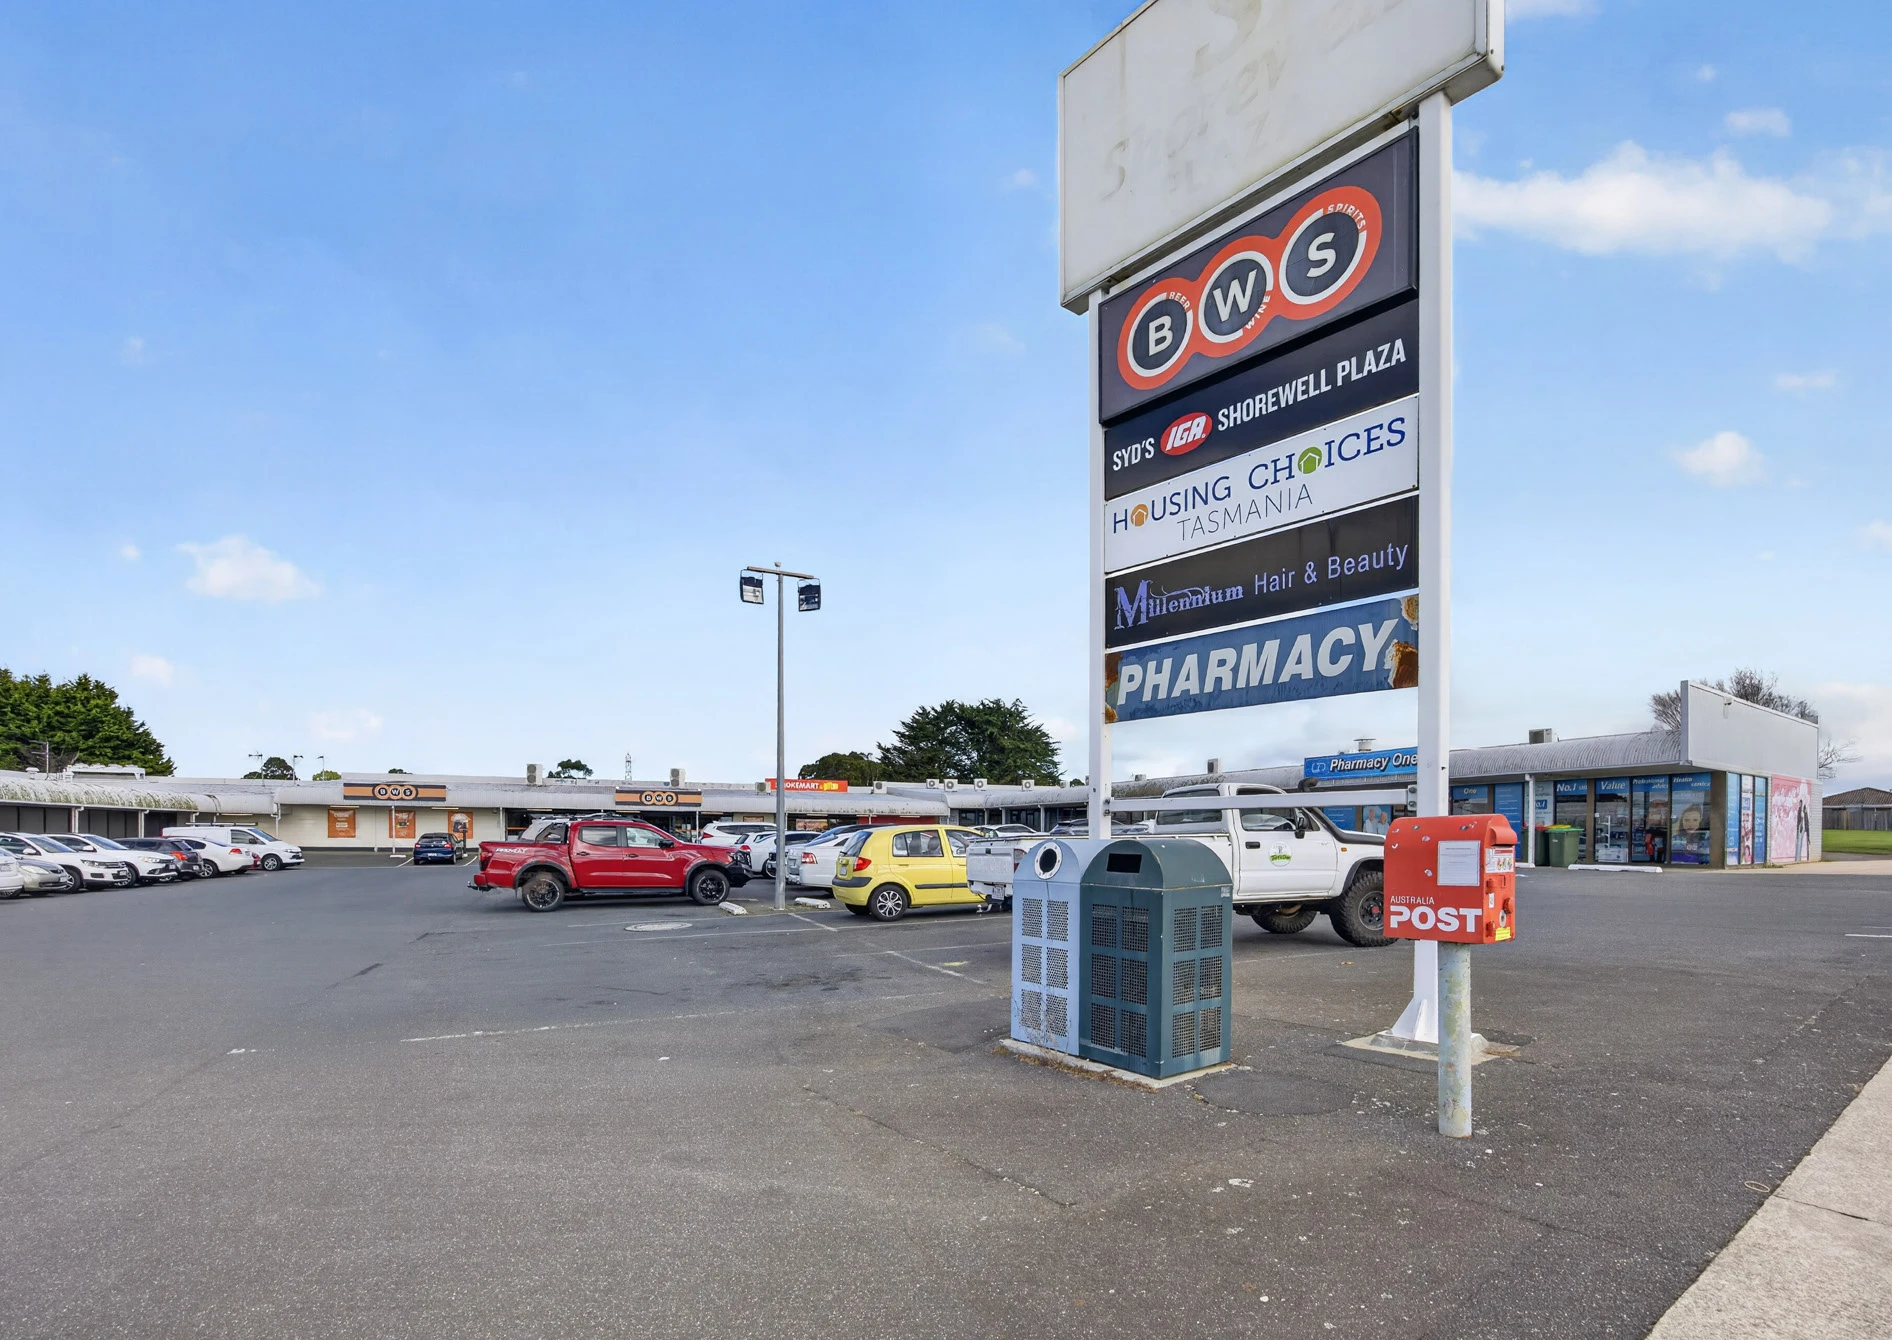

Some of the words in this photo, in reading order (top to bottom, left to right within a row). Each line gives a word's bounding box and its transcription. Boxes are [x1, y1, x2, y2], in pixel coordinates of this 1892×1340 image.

[1326, 203, 1367, 231] SPIRITS
[1168, 291, 1191, 312] BEER
[1245, 294, 1271, 330] WINE
[1112, 437, 1155, 471] SYD'S
[1164, 415, 1207, 452] IGA
[1218, 368, 1332, 431] SHOREWELL
[1336, 338, 1407, 387] PLAZA
[1112, 476, 1232, 534] HOUSING
[1248, 417, 1406, 489] CHOICES
[1177, 484, 1313, 541] TASMANIA
[1113, 579, 1244, 630] Millennium
[1254, 568, 1295, 595] Hair
[1304, 561, 1318, 585] &
[1327, 543, 1408, 580] Beauty
[1117, 618, 1399, 706] PHARMACY
[1329, 756, 1390, 772] Pharmacy
[1392, 752, 1417, 766] One
[775, 782, 819, 790] OKEMART
[1601, 781, 1626, 790] Value
[1389, 895, 1435, 905] AUSTRALIA
[1389, 905, 1482, 932] POST
